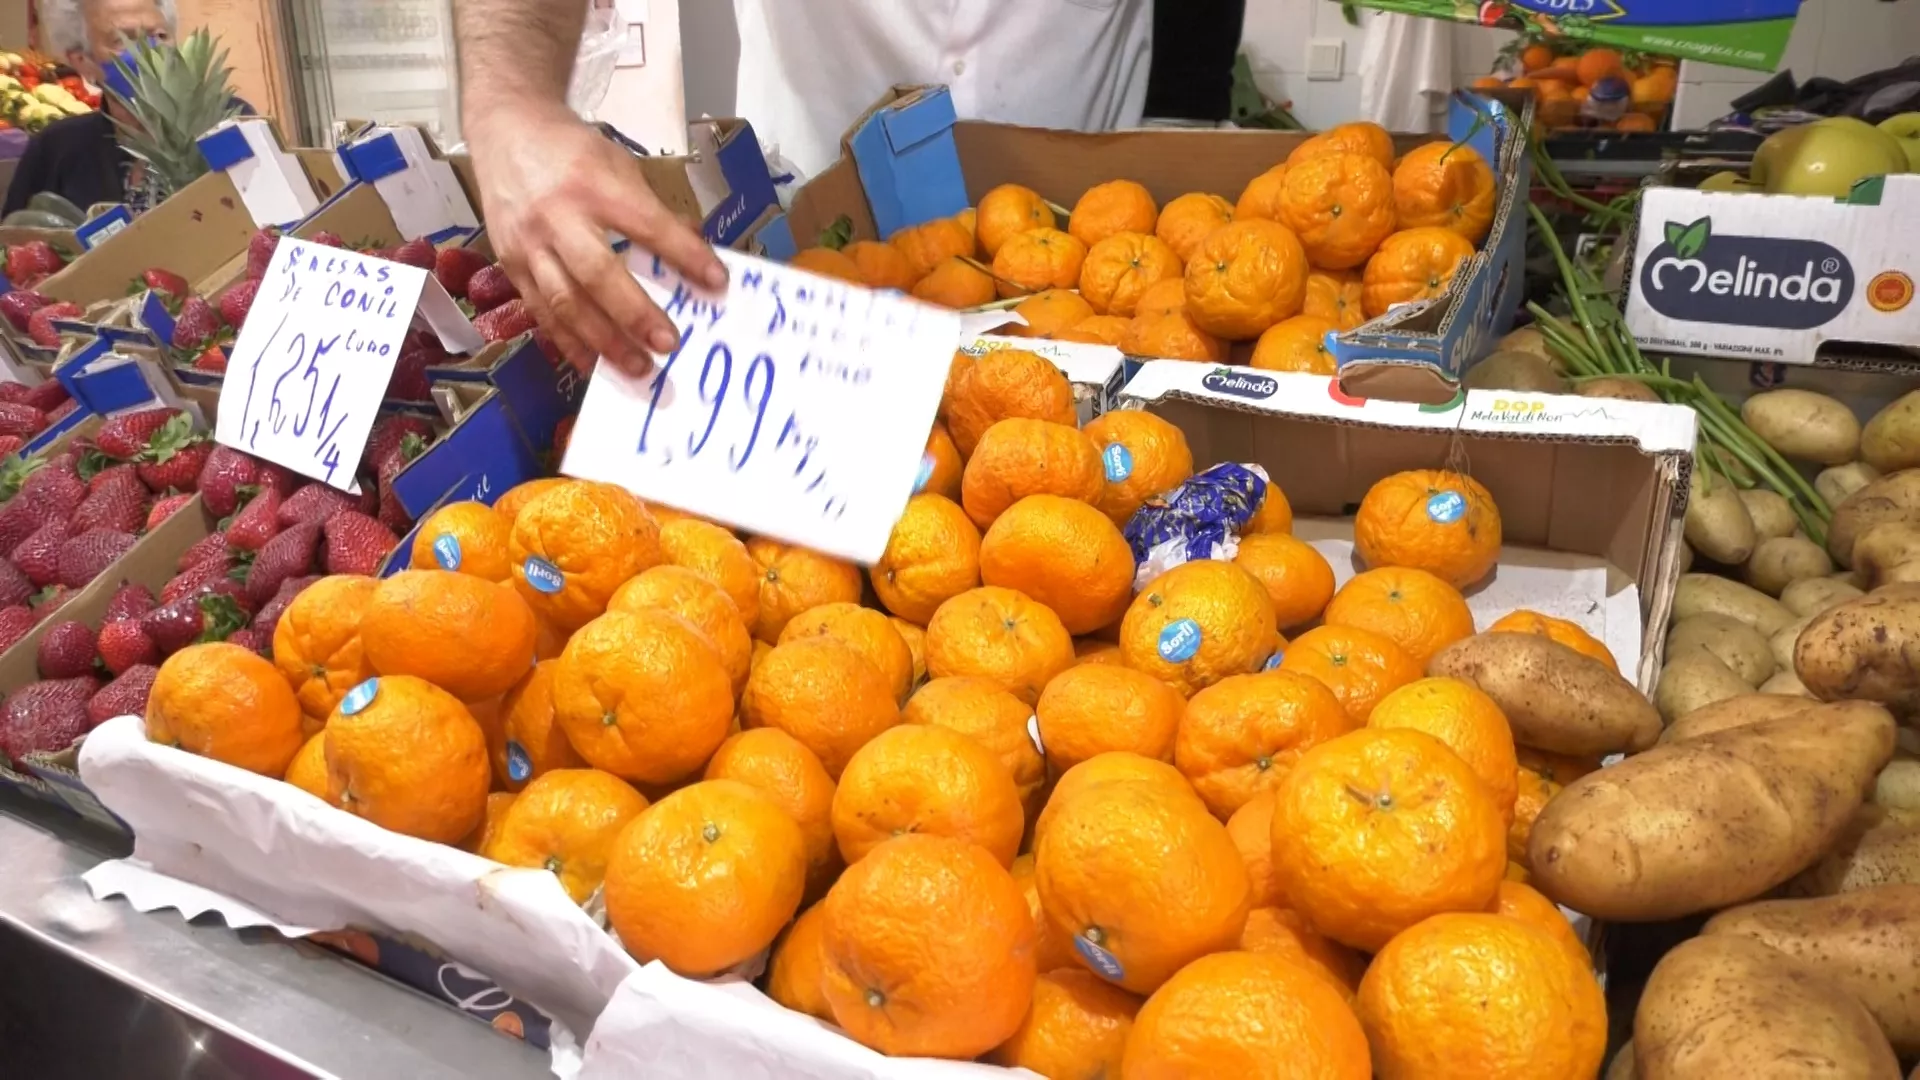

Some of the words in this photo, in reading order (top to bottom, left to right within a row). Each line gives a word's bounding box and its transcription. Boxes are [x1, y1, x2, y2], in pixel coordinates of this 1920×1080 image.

[1492, 398, 1546, 412] DOP
[1470, 409, 1500, 421] Mela
[1536, 413, 1562, 422] Non
